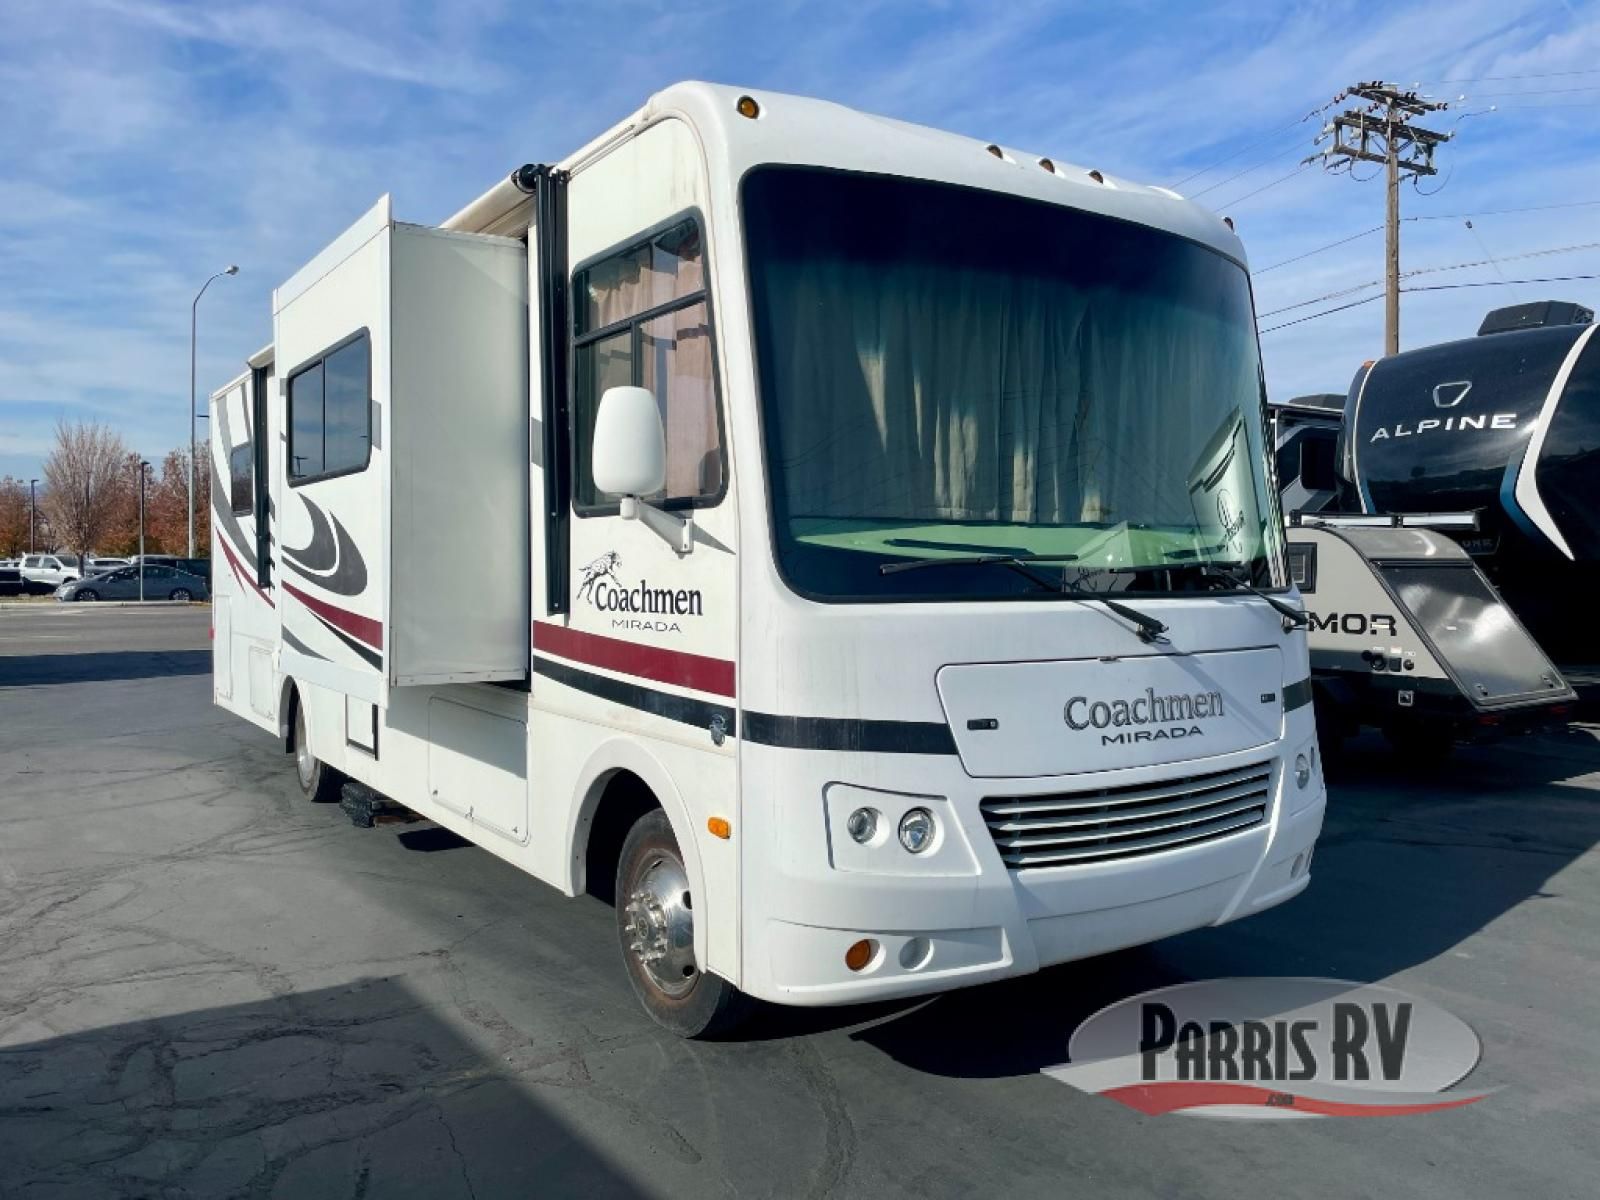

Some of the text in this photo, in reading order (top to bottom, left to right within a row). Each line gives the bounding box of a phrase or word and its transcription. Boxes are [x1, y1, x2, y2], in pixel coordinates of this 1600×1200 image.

[1370, 413, 1518, 443] ALPINE
[594, 579, 703, 616] Coachmen
[611, 619, 682, 633] MIRADA
[1308, 612, 1398, 636] MOR
[1063, 687, 1224, 731] Coachmen
[1101, 725, 1205, 746] MIRADA
